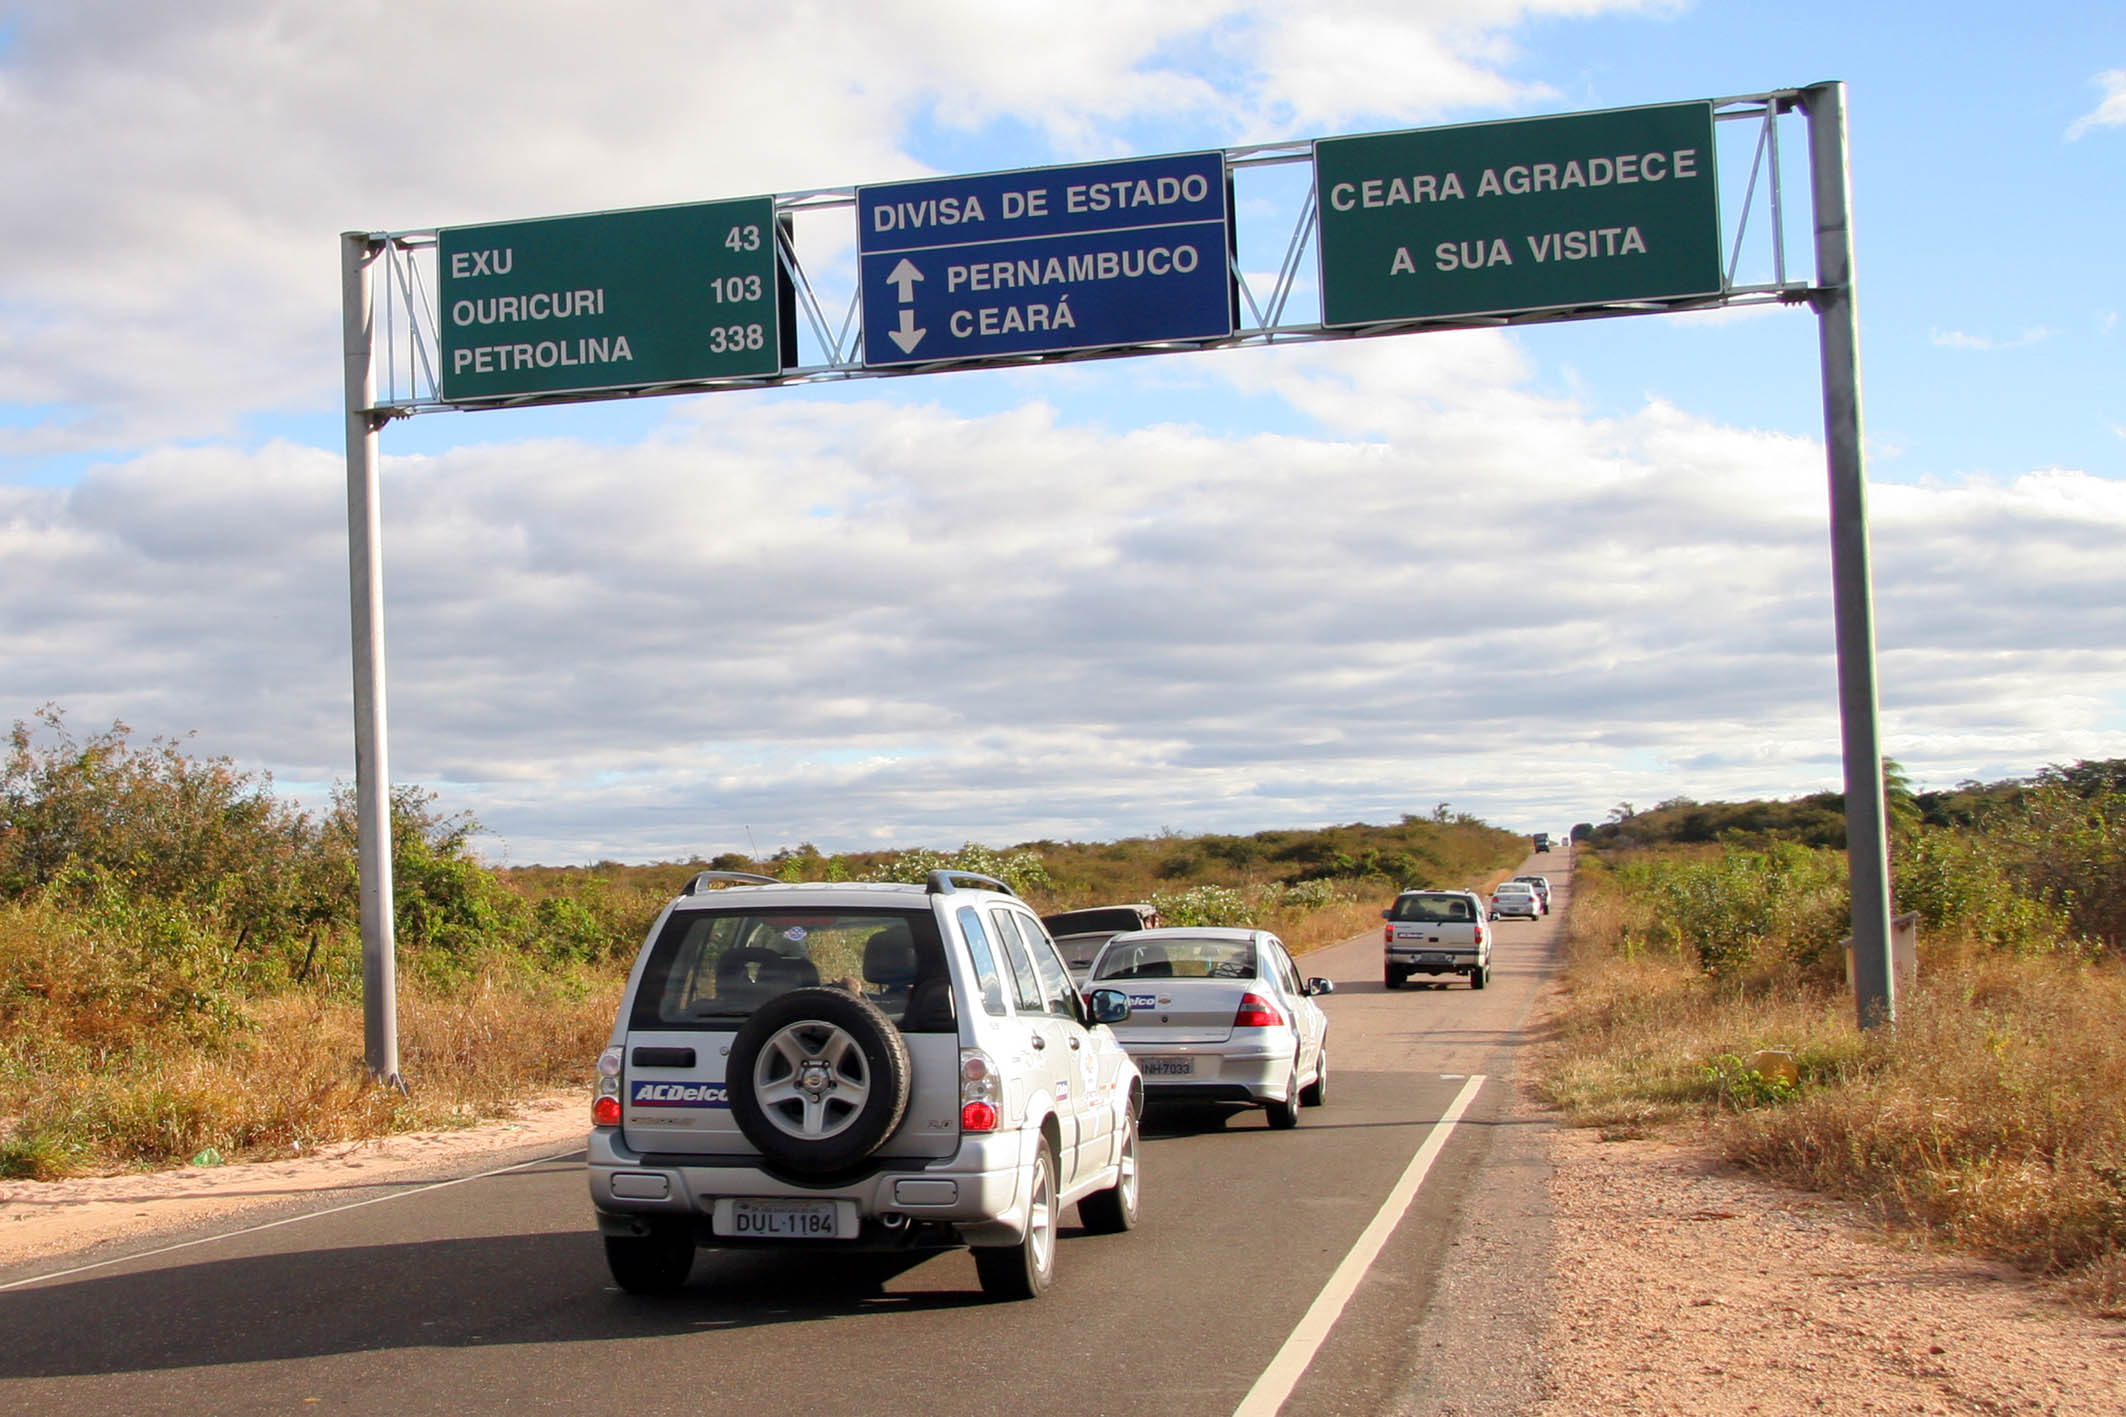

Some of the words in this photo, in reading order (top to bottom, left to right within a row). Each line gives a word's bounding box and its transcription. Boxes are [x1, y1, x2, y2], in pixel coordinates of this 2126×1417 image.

[874, 196, 985, 232] DIVISA
[1002, 189, 1049, 219] DE
[1067, 174, 1208, 213] ESTADO
[1331, 172, 1465, 212] CEARA
[1476, 148, 1698, 198] AGRADECE
[452, 248, 512, 278] EXU
[725, 225, 760, 251] 43
[947, 245, 1198, 292] PERNAMBUCO
[1390, 247, 1416, 276] A
[1435, 238, 1513, 272] SUA
[1528, 225, 1647, 264] VISITA
[453, 289, 603, 326] OURICURI
[711, 275, 761, 303] 103
[951, 294, 1075, 337] CEARÁ
[455, 336, 632, 374] PETROLINA
[710, 324, 763, 352] 338
